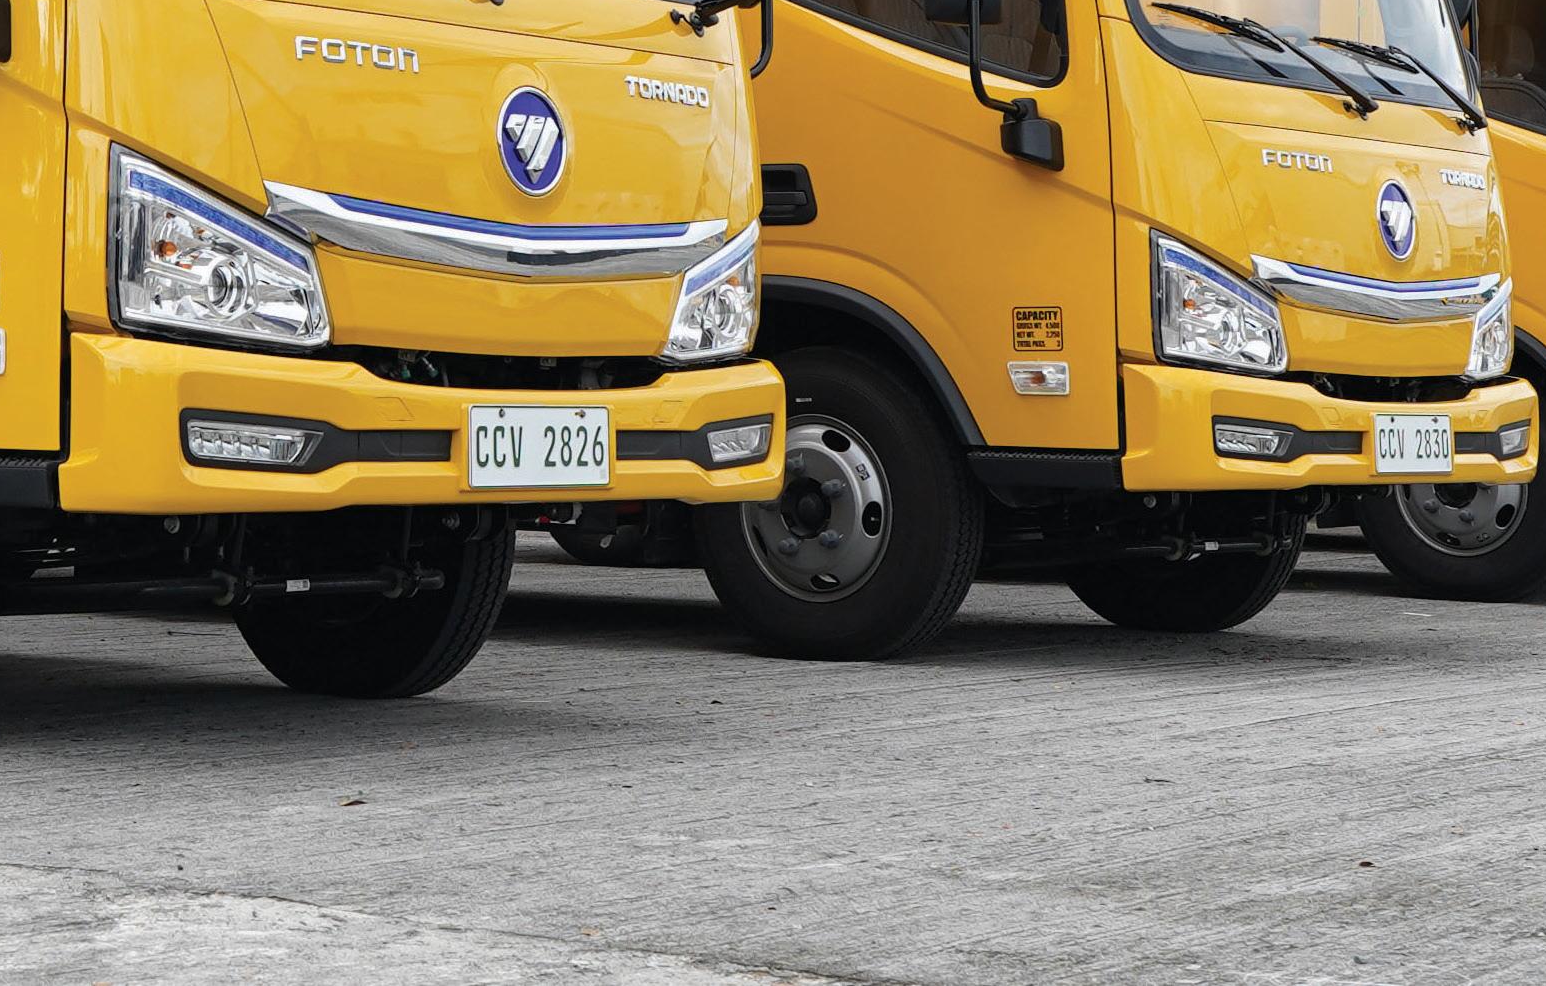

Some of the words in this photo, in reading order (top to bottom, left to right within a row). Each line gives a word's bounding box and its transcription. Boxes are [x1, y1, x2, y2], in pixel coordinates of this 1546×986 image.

[294, 35, 420, 74] FOTON
[623, 74, 711, 109] TORNADO
[1261, 148, 1334, 174] FOTON
[1016, 310, 1058, 321] CAPACITY
[476, 425, 523, 468] CCV
[544, 425, 604, 468] 2826
[1379, 428, 1404, 459] CCV
[1415, 428, 1450, 459] 2830
